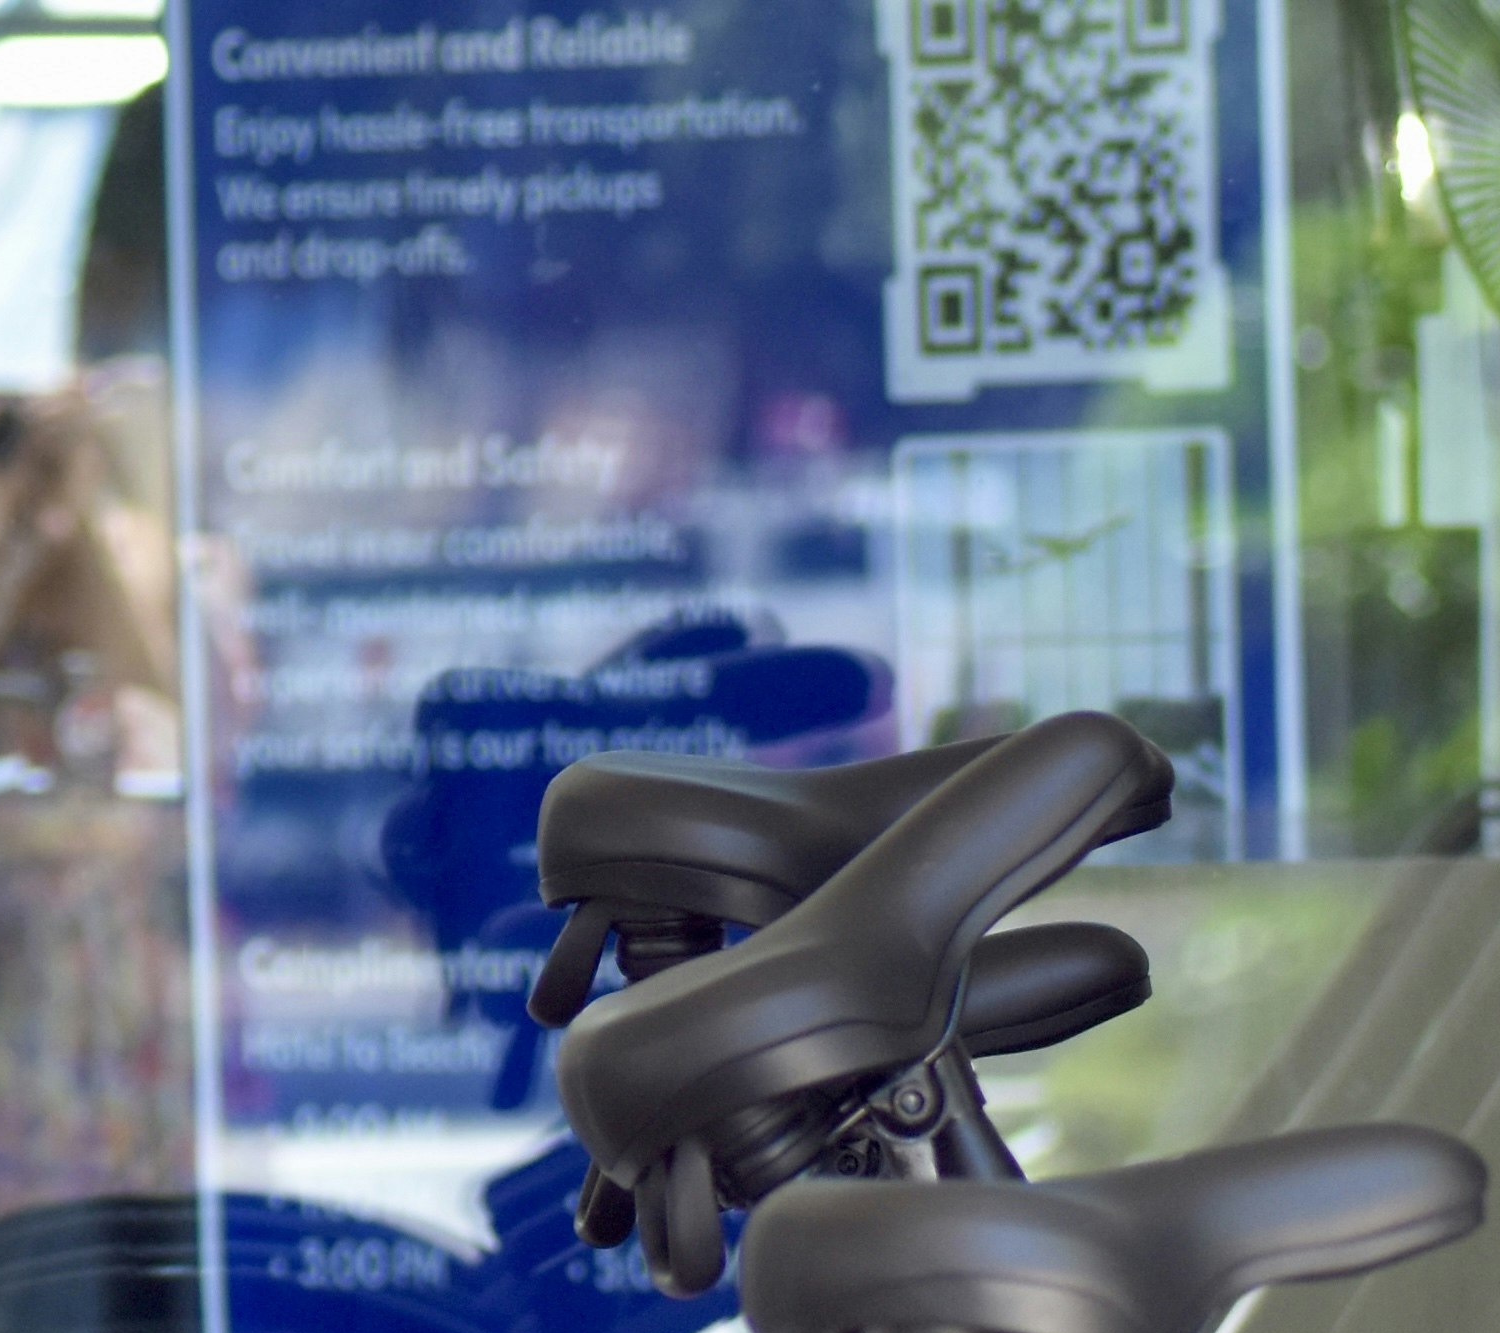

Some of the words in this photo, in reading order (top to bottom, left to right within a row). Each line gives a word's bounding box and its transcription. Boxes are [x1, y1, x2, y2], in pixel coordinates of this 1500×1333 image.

[211, 20, 435, 82] Convenient
[440, 14, 523, 74] and
[530, 10, 691, 70] Reliable
[214, 103, 314, 165] Enjoy
[319, 97, 522, 153] hassle-free
[529, 90, 805, 152] transportation.
[215, 173, 278, 221] We
[283, 178, 399, 220] ensure
[405, 164, 516, 225] timely
[522, 162, 663, 222] pickups
[216, 229, 294, 281] and
[225, 436, 397, 494] Comfort
[403, 432, 478, 488] and
[482, 430, 623, 494] Safety
